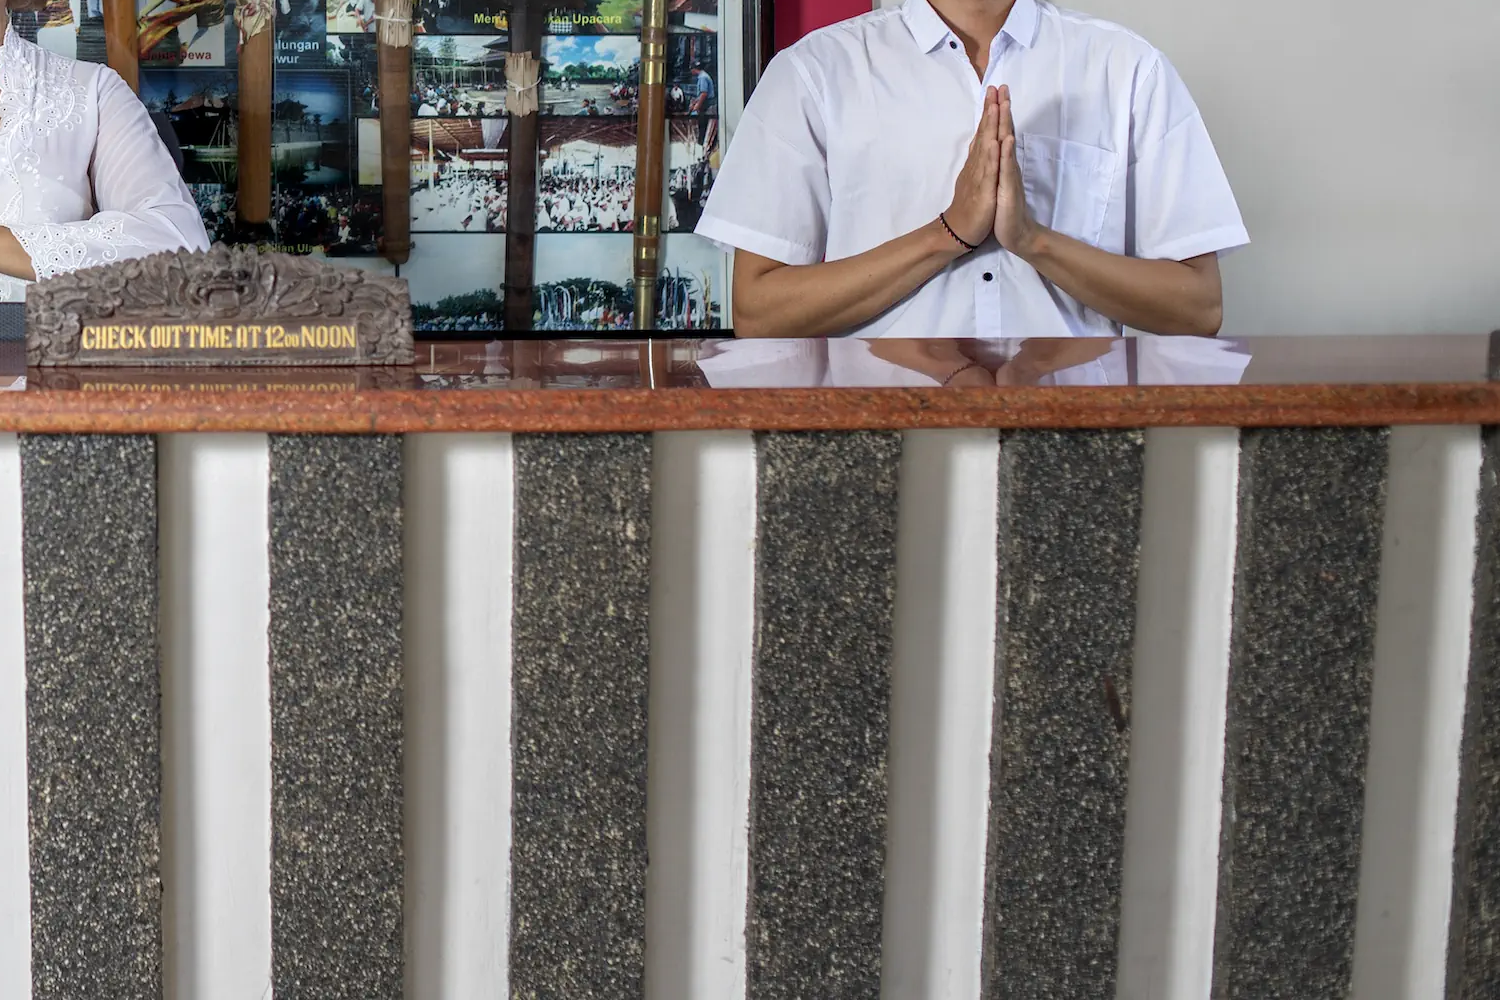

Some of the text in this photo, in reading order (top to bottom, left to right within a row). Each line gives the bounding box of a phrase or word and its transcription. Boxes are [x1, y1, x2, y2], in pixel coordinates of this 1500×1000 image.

[572, 13, 622, 26] Upacara
[275, 39, 320, 53] lungan
[275, 55, 300, 64] wur
[82, 326, 147, 350] CHECK
[150, 326, 182, 349] OUT
[183, 326, 233, 349] TIME
[237, 326, 262, 349] AT
[301, 326, 356, 348] NOON
